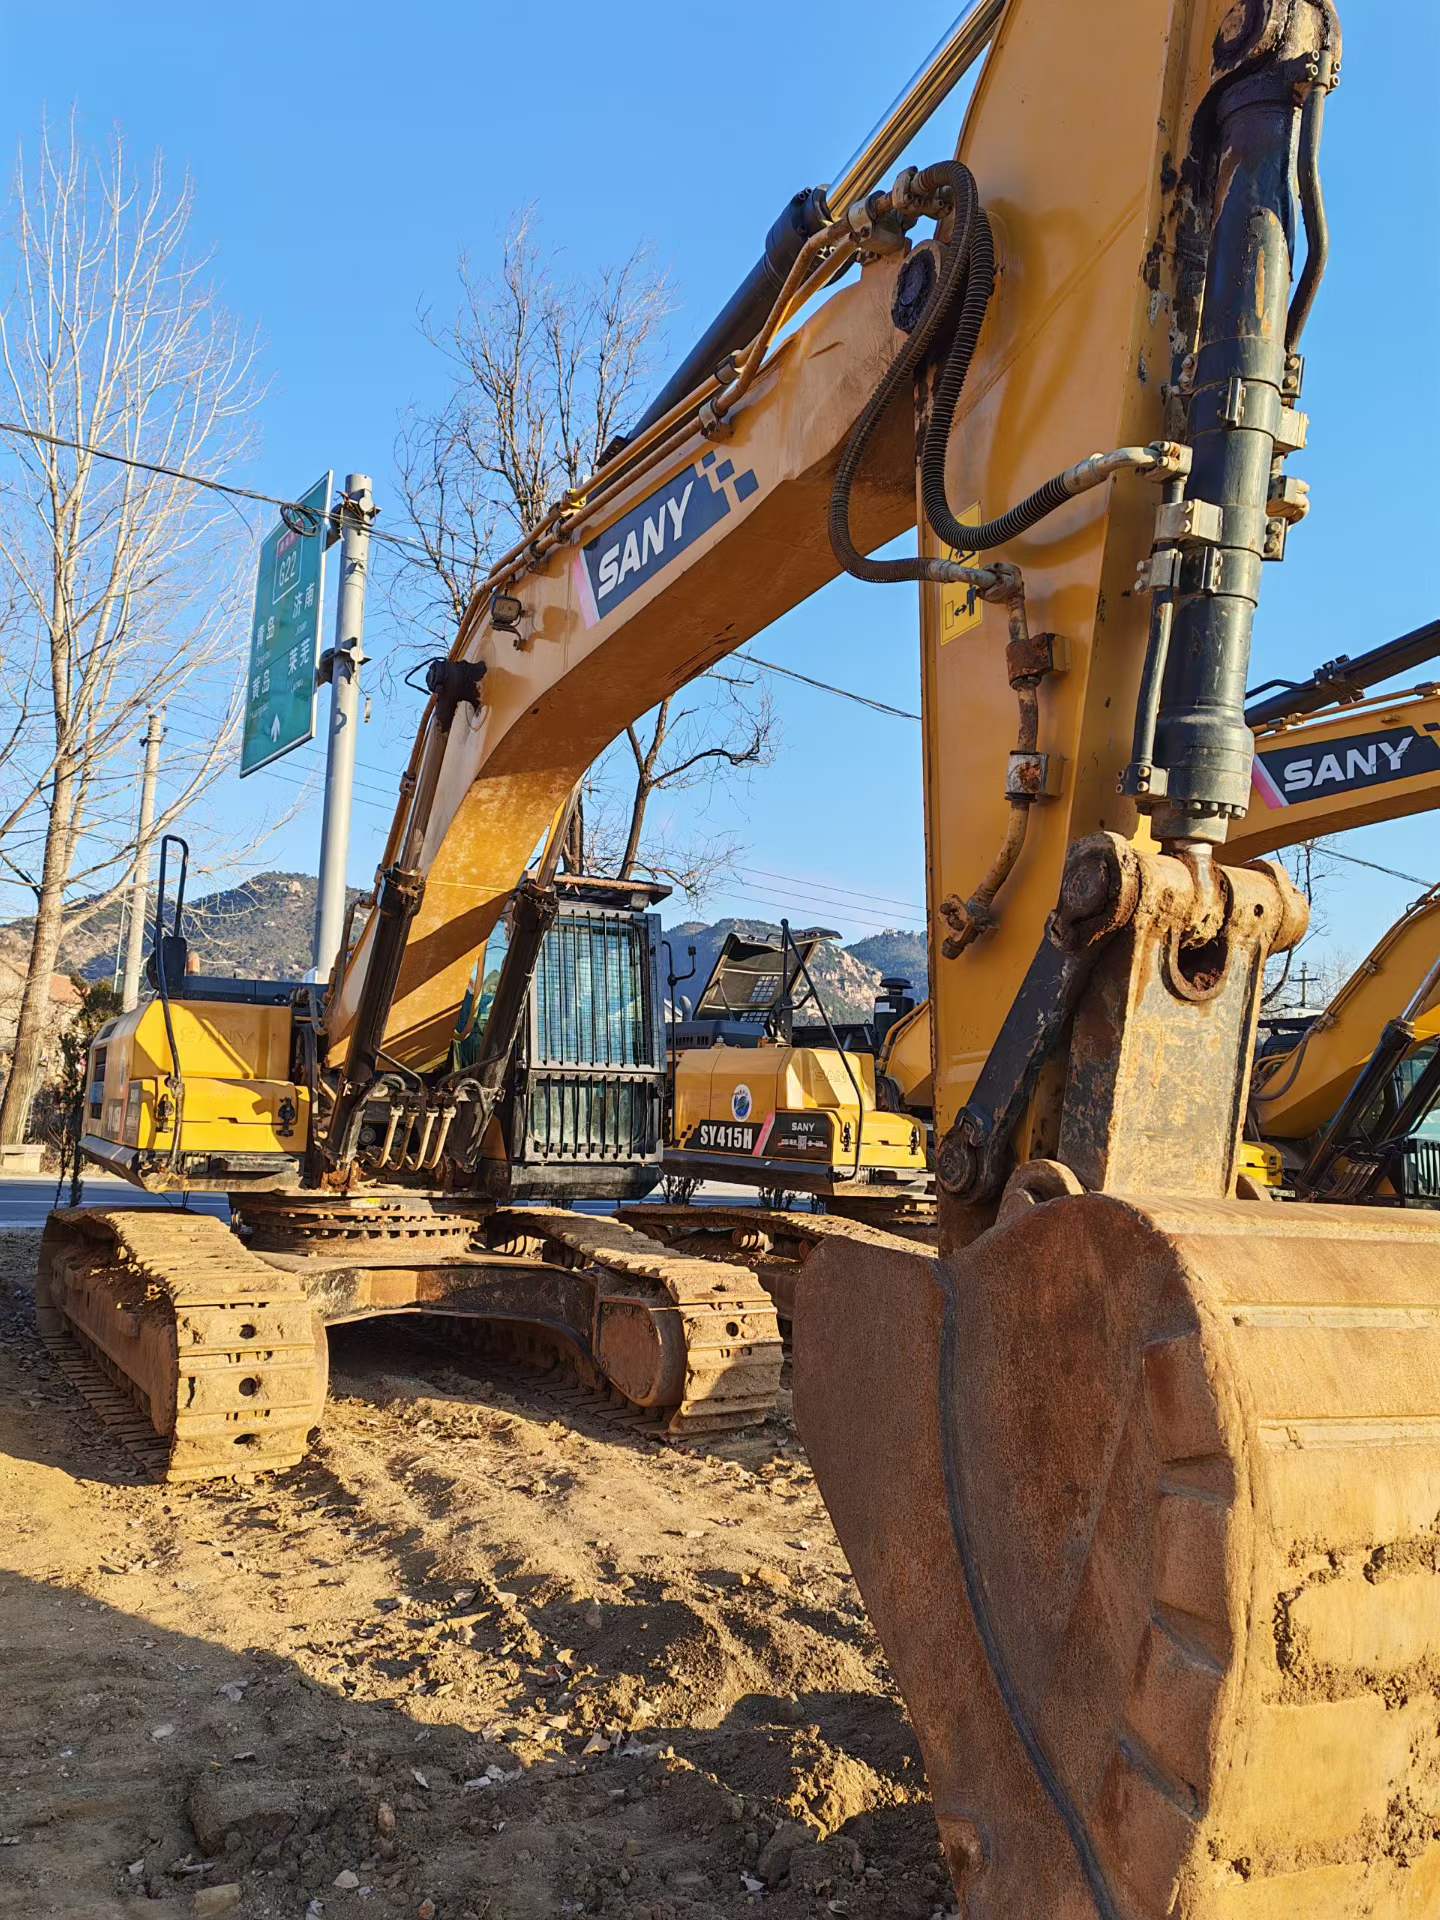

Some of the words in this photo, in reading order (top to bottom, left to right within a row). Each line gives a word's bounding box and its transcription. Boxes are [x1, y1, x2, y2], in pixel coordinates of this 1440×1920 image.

[598, 480, 694, 600] SANY
[278, 550, 297, 587] G22
[292, 582, 315, 618] 济南
[1284, 736, 1414, 792] SANY
[700, 1124, 753, 1150] SY415H
[791, 1122, 815, 1132] SANY
